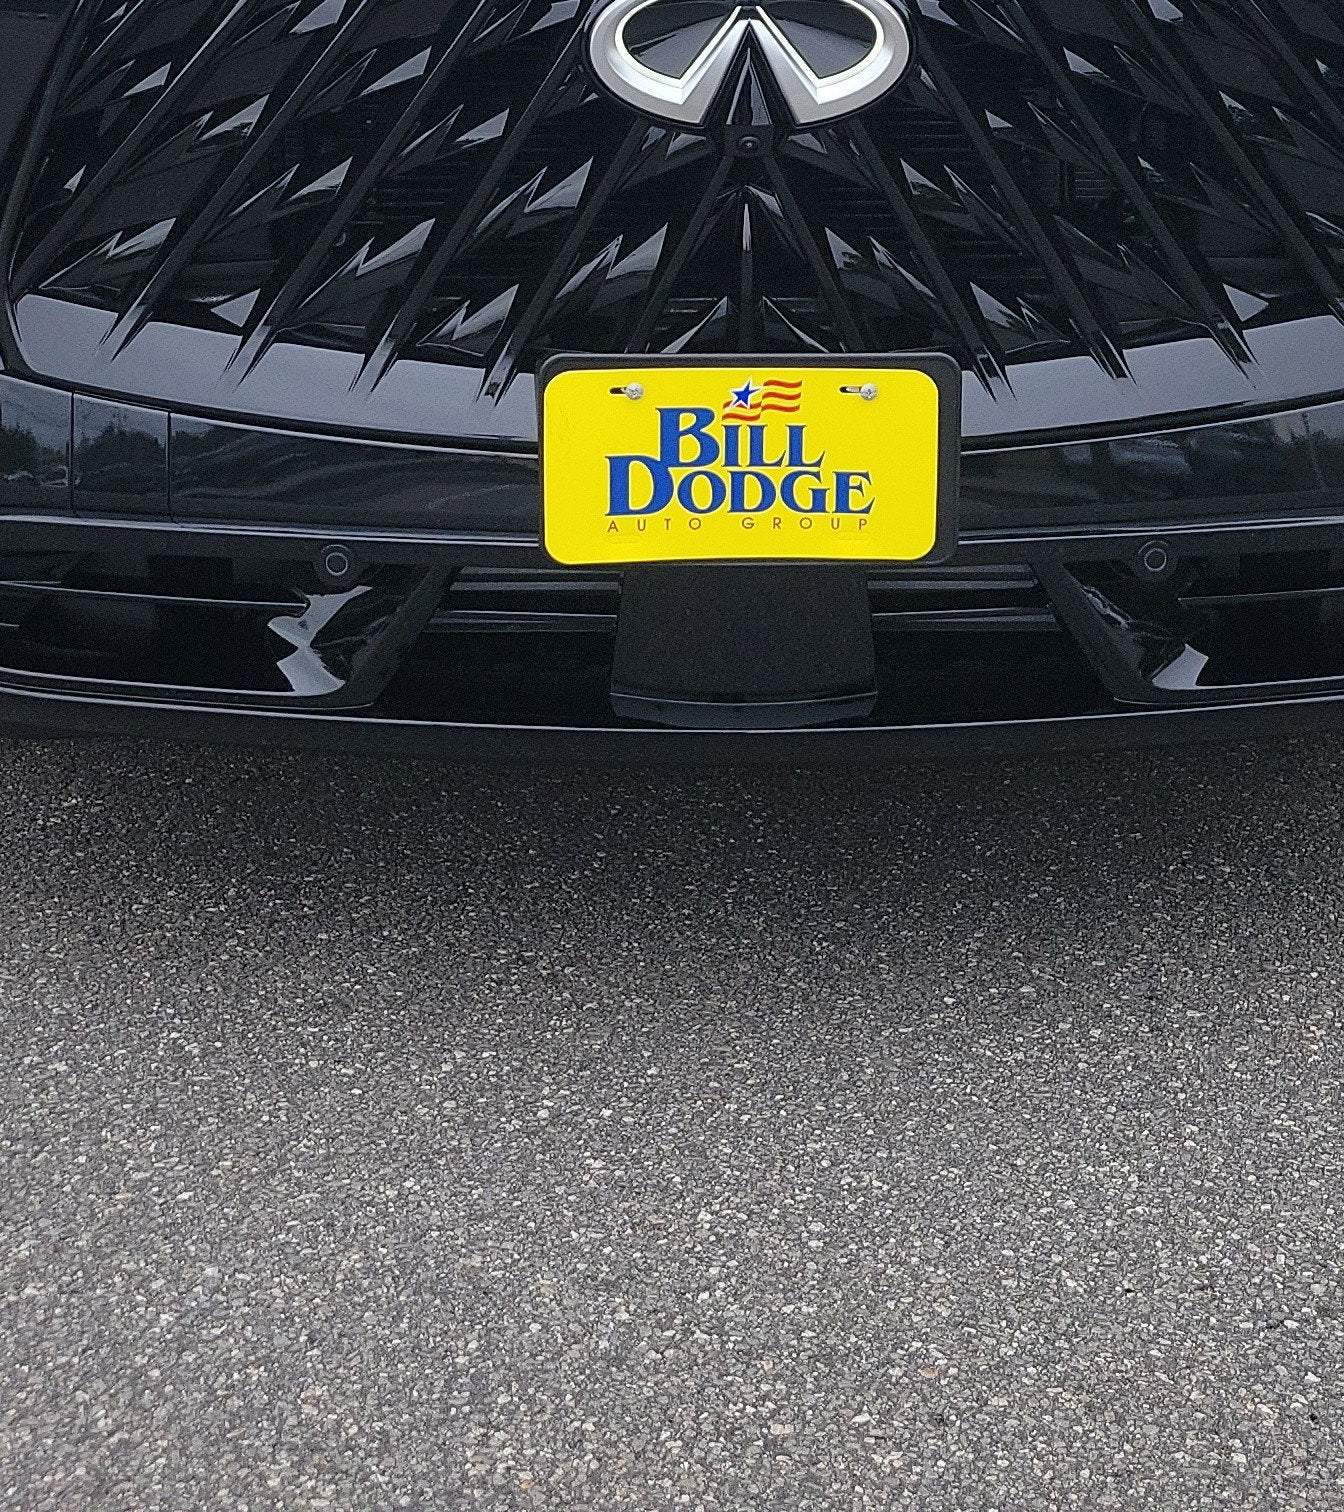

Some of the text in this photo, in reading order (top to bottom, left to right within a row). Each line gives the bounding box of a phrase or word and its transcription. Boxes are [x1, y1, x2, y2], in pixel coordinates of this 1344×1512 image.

[654, 407, 825, 468] BILL
[604, 454, 876, 517] DODGE
[606, 516, 869, 533] AUTO GROUP
